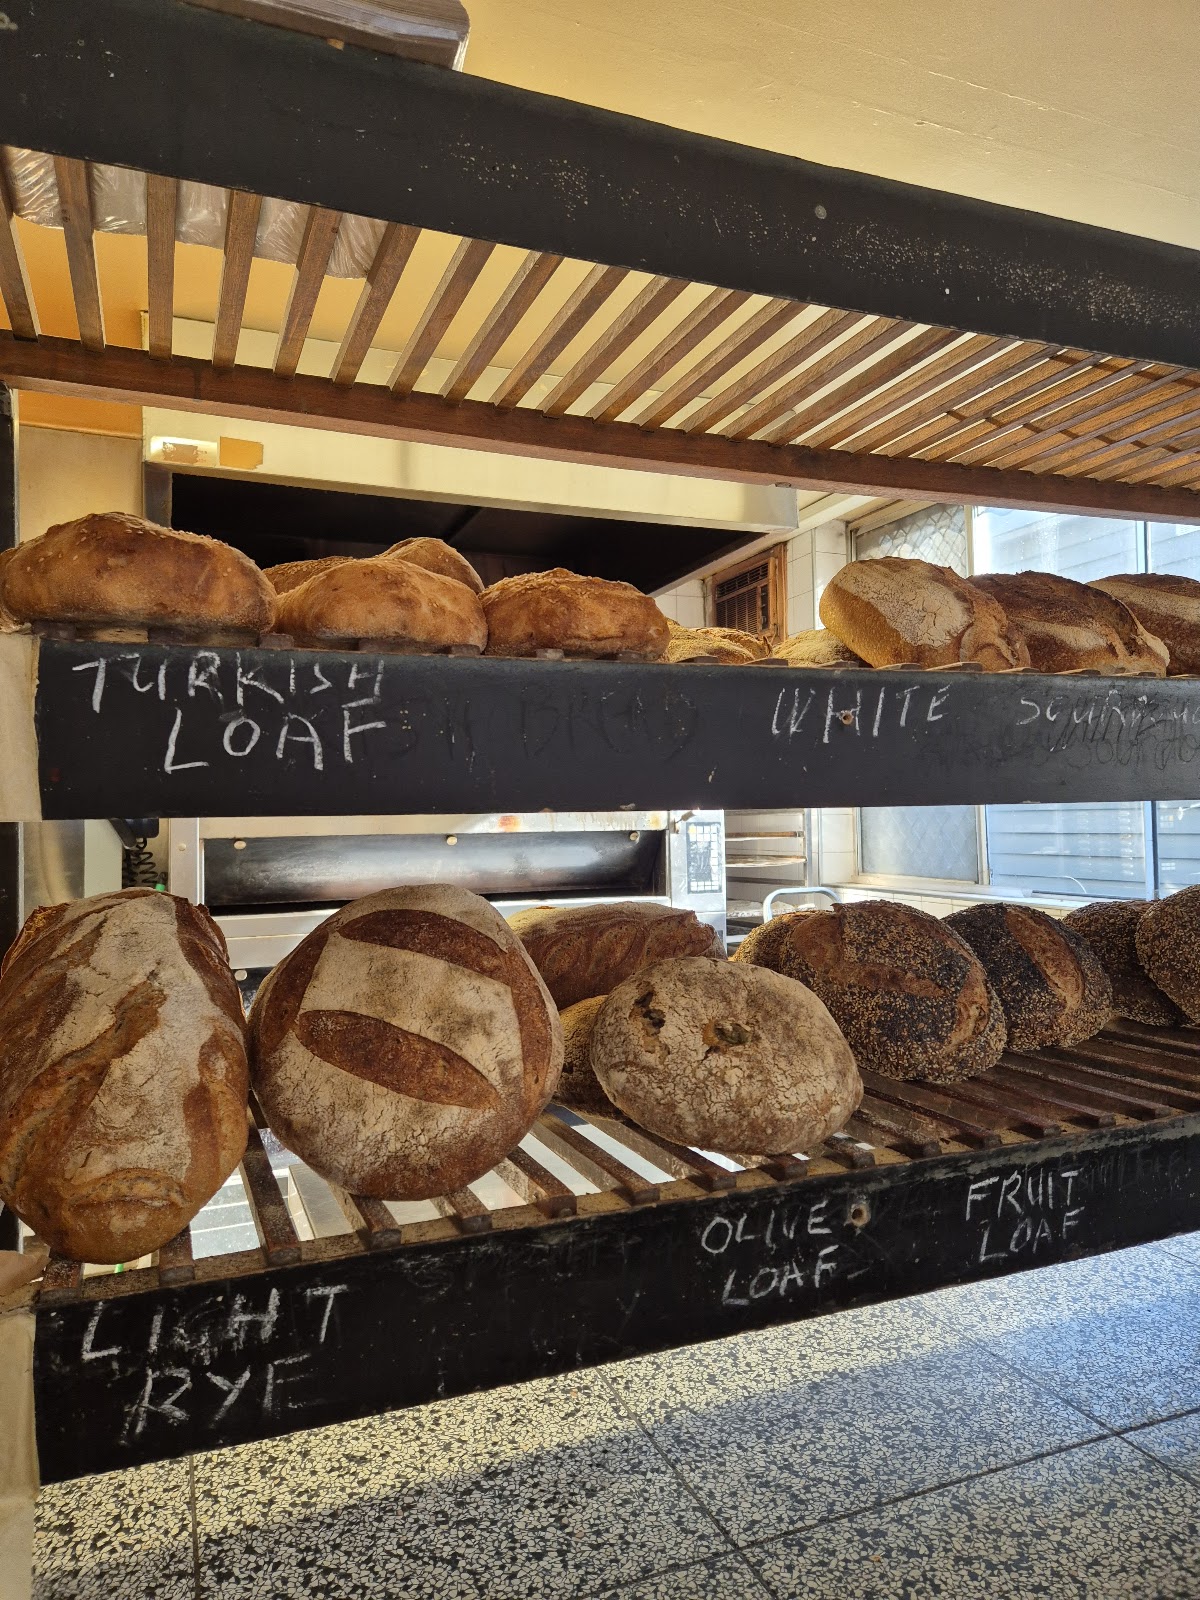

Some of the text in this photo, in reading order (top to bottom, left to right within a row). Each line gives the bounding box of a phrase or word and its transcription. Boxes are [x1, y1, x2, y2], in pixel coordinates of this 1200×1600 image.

[72, 651, 385, 714] TURKISH
[771, 682, 951, 744] WHITE
[164, 699, 387, 775] LOAF
[966, 1167, 1083, 1222] FRUIT
[701, 1200, 832, 1254] OLIVE
[978, 1206, 1086, 1264] LOAF
[722, 1244, 839, 1306] LOAF
[118, 1353, 318, 1446] RYE
